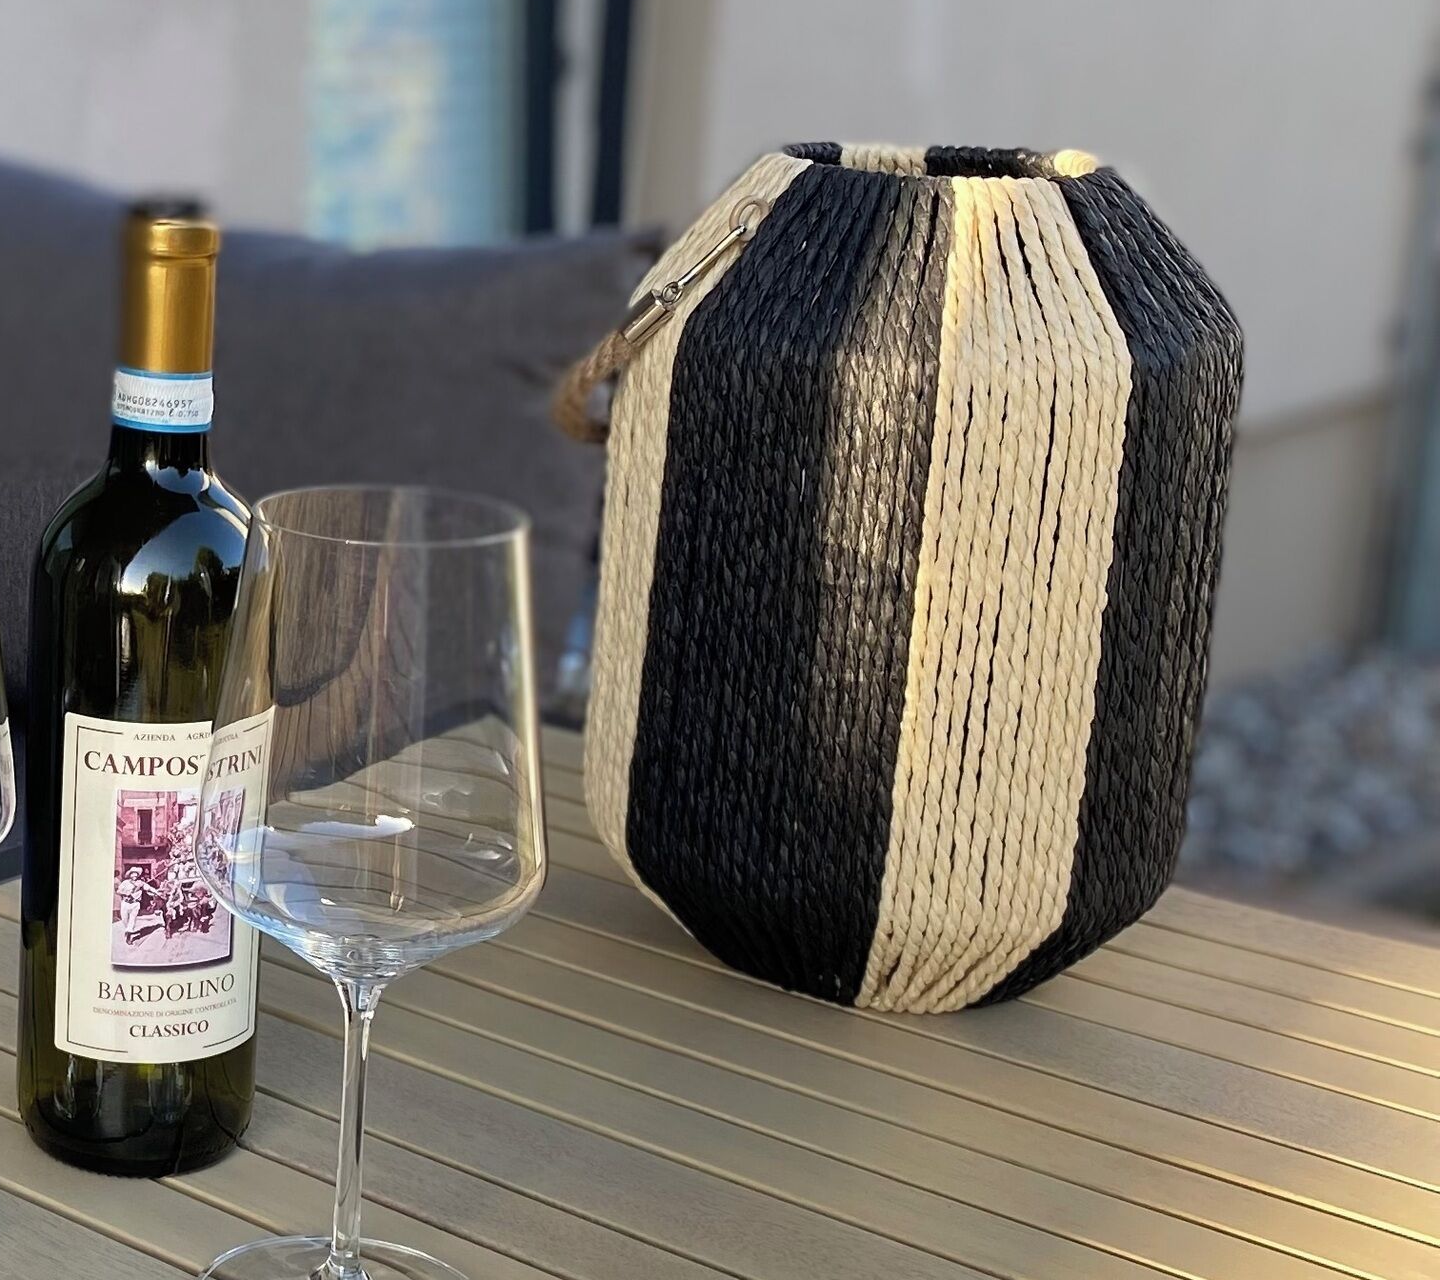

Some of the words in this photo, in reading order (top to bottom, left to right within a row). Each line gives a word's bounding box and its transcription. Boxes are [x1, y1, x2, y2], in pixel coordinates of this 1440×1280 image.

[133, 733, 176, 742] AZIENDA
[98, 973, 235, 1003] BARDOLINO
[92, 1006, 154, 1018] DENOMINAZIONE
[165, 1009, 194, 1017] ORIGINE
[195, 998, 237, 1014] CONTROLLATA
[129, 1020, 209, 1038] CLASSICO
